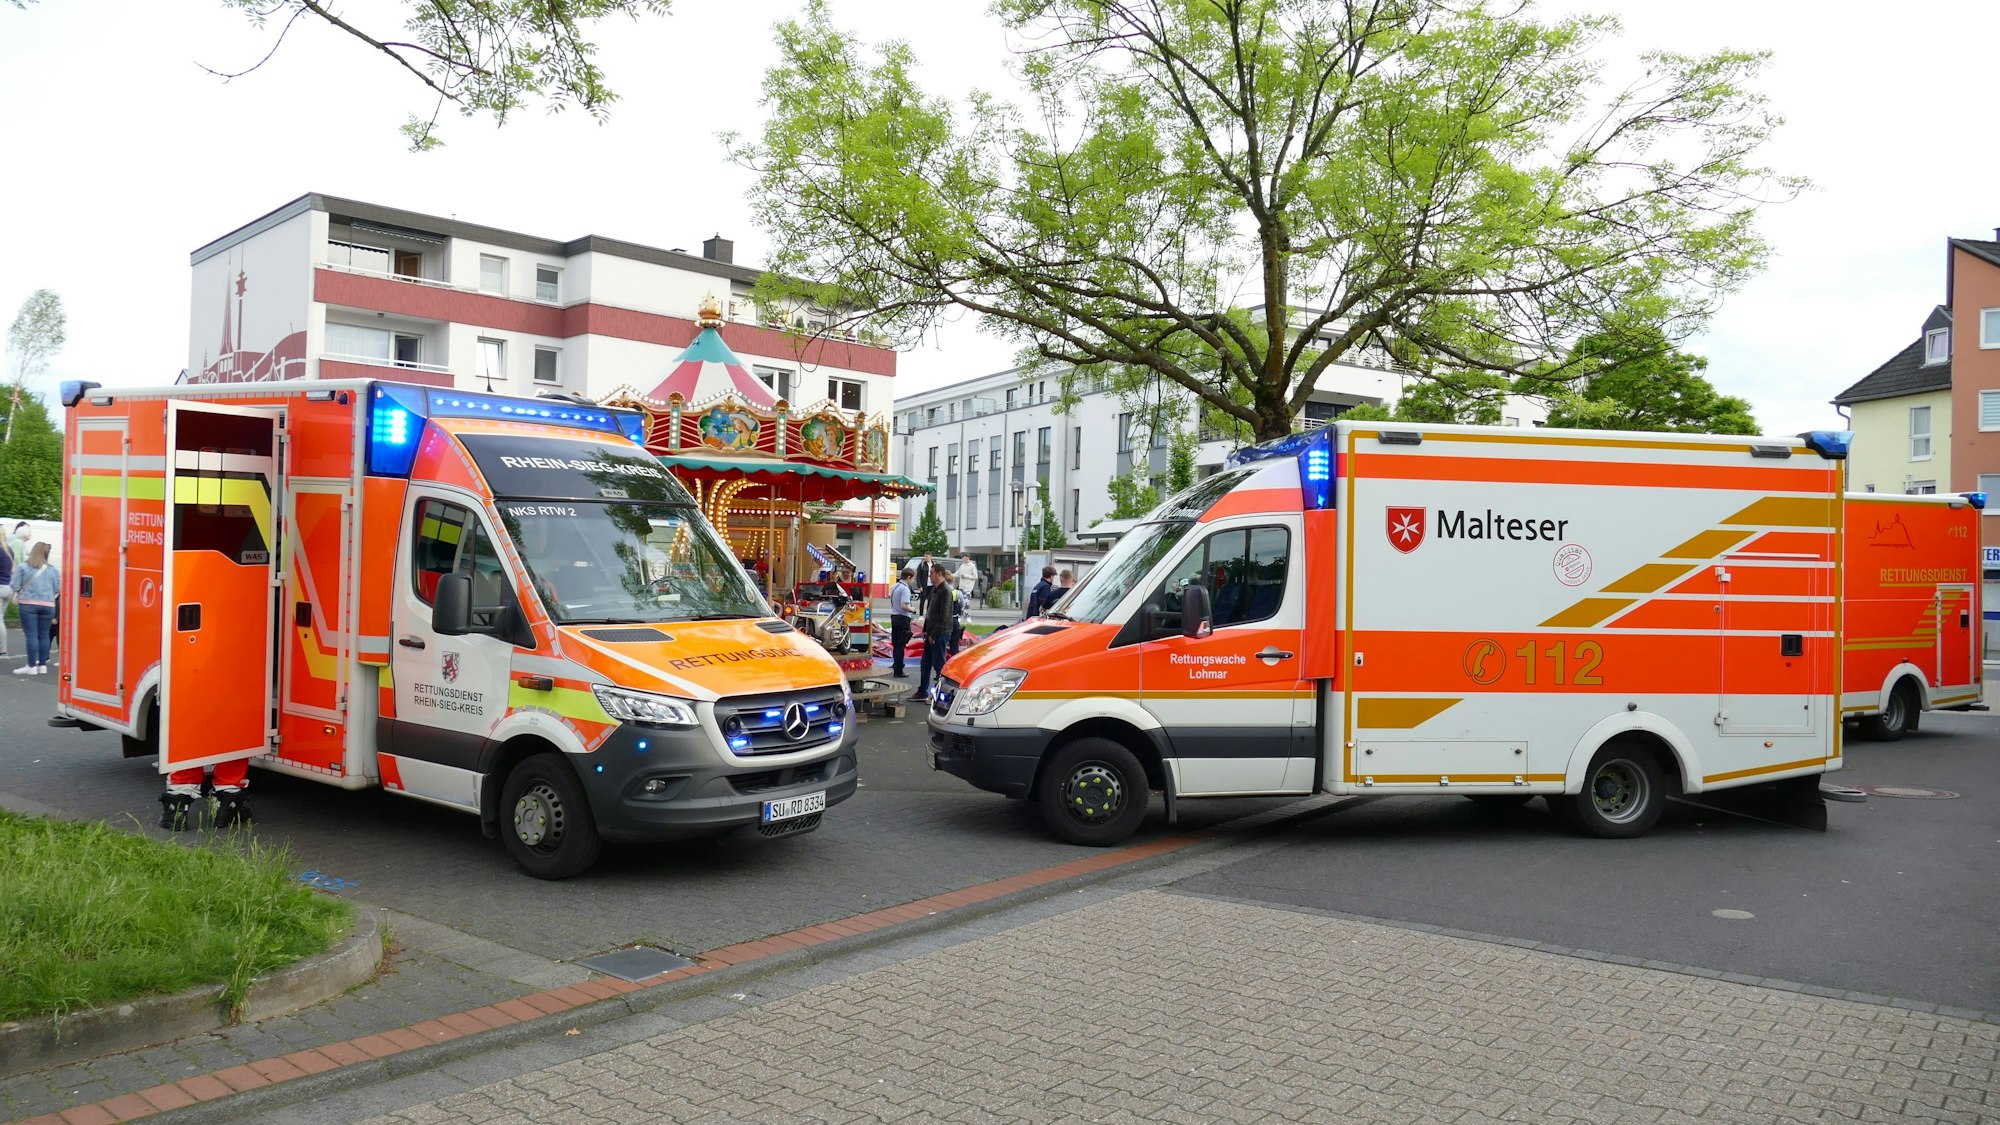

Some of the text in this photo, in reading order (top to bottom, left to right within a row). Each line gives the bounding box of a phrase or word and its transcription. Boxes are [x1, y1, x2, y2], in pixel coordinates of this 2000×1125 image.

[500, 456, 663, 479] RHEIN-SIEG-KREIS
[128, 511, 165, 528] RETTUN
[508, 506, 577, 517] NKS RTW 2
[1437, 509, 1569, 541] Malteser
[1954, 526, 1968, 538] 112
[1880, 568, 1968, 582] RETTUNGSDIENST
[1170, 653, 1246, 666] Rettungswache
[1516, 639, 1604, 685] 112
[1189, 668, 1228, 679] Lohmar
[414, 683, 484, 703] RETTUNGSDIENST
[414, 695, 484, 716] RHEIN-SIEG-KREIS
[772, 802, 786, 818] SU
[790, 799, 803, 815] RD
